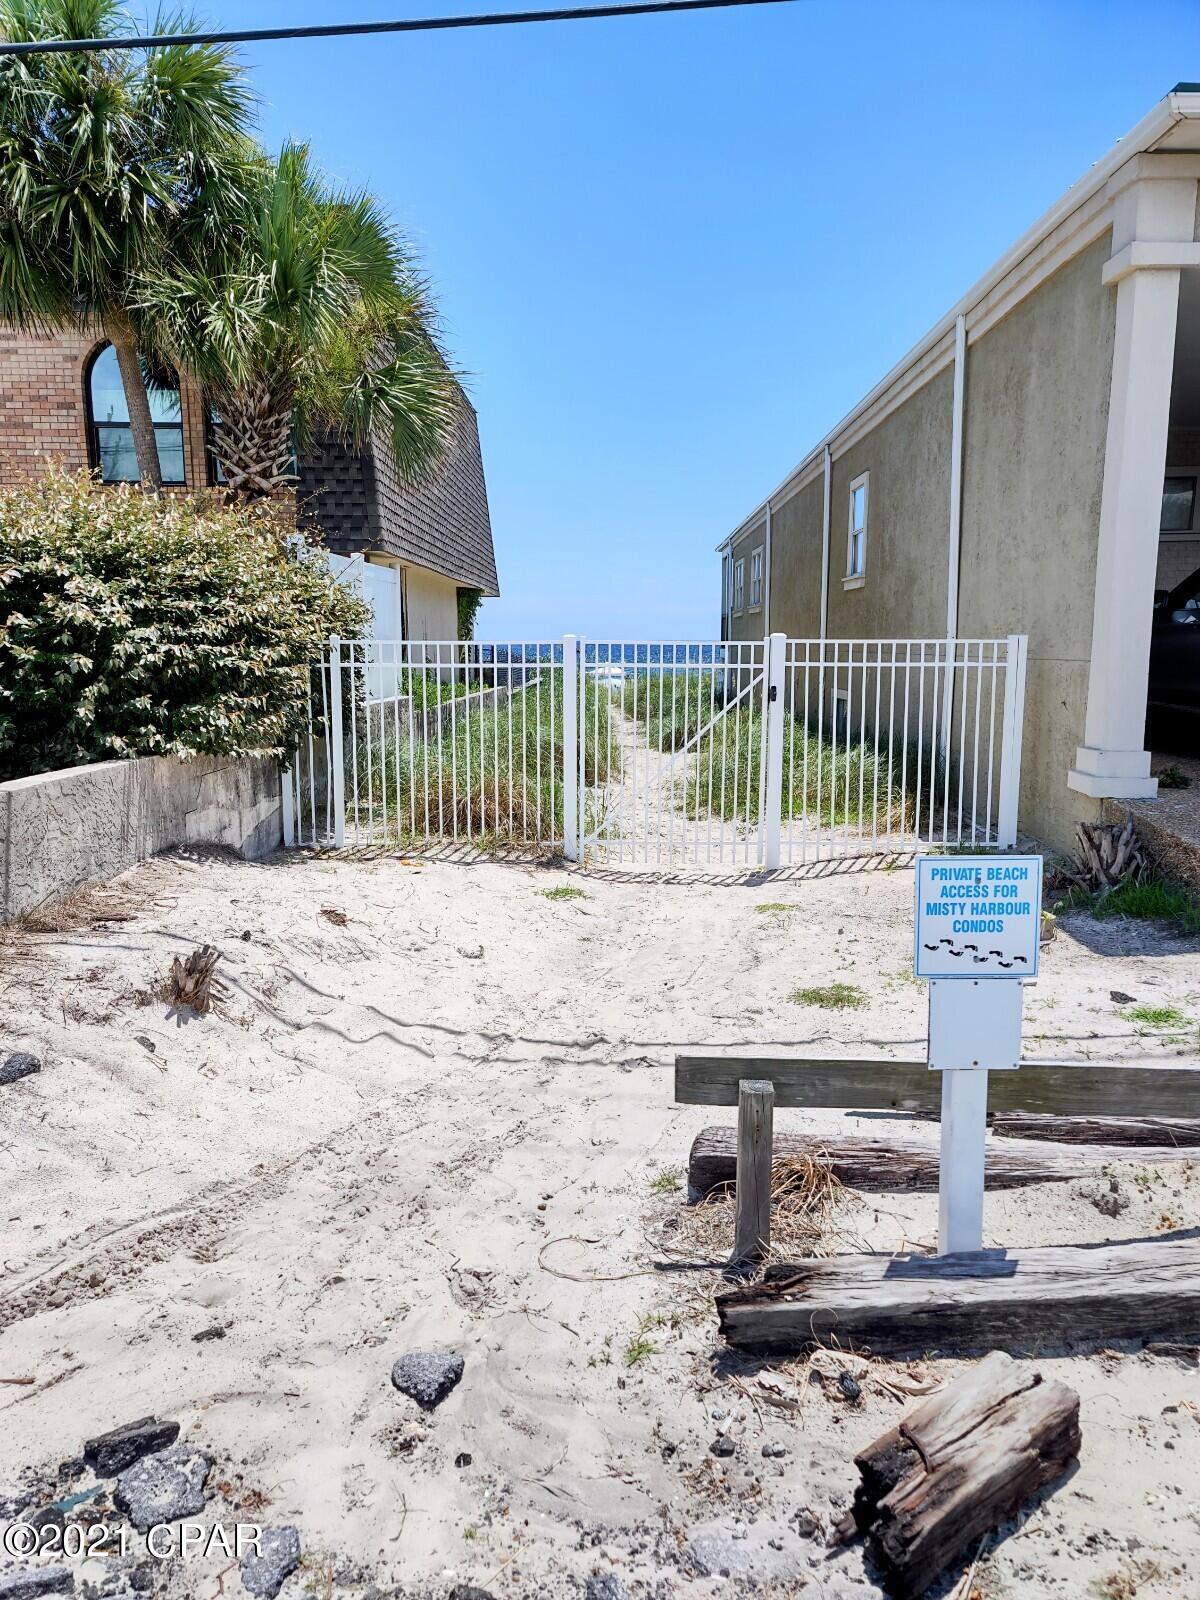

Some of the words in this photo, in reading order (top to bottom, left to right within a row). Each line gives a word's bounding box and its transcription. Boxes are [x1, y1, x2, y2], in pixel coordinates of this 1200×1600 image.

[931, 867, 982, 881] PRIVATE
[987, 867, 1028, 880] BEACH
[940, 884, 989, 898] ACCESS
[993, 884, 1018, 898] FOR
[926, 902, 966, 916] MISTY
[970, 902, 1030, 916] HARBOUR
[953, 919, 1004, 933] CONDOS
